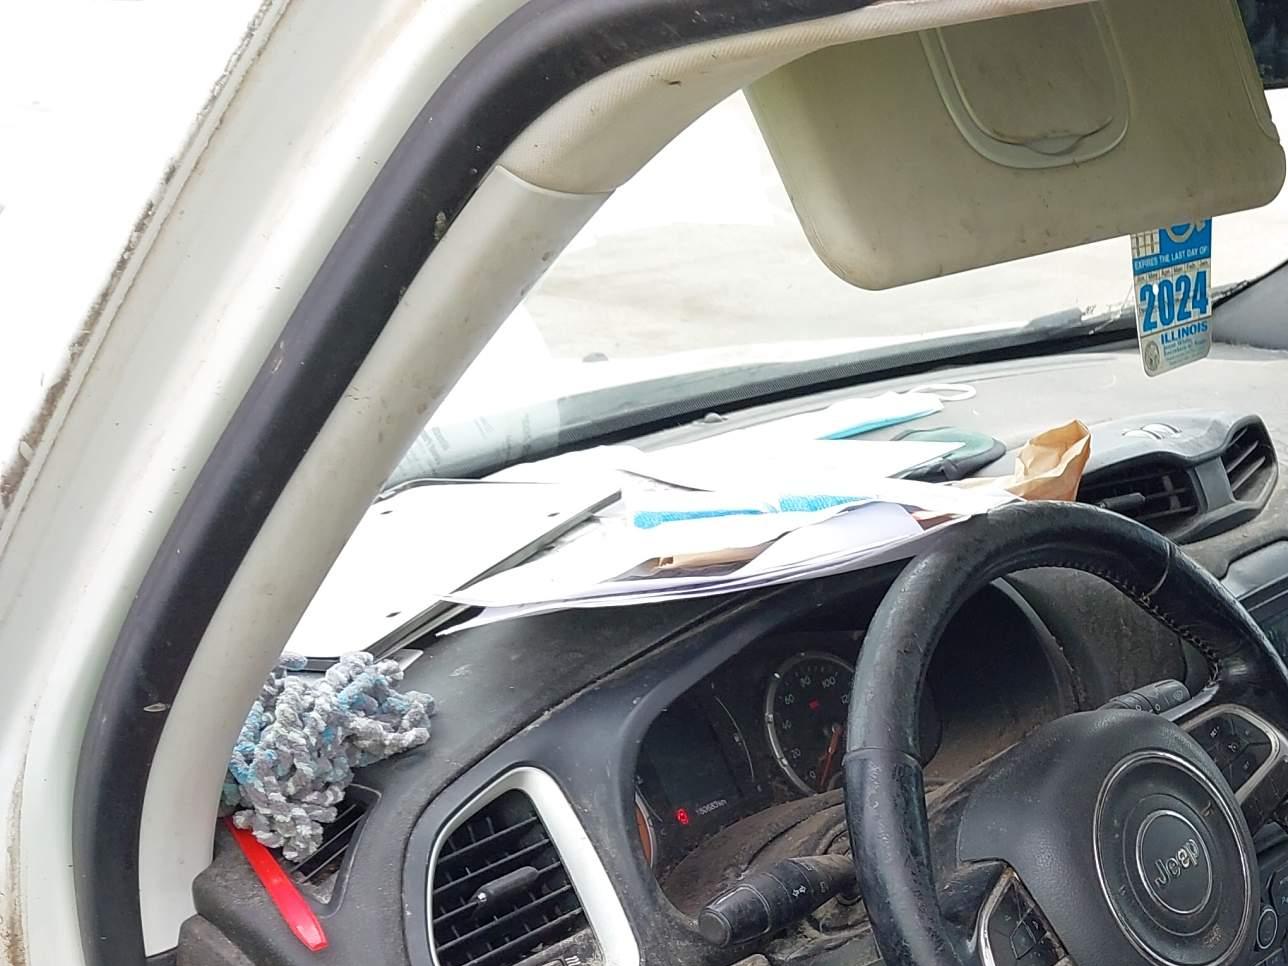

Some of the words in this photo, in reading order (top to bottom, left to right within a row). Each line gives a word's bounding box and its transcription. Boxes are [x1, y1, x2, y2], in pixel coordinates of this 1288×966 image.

[1133, 256, 1158, 270] EXPIRES
[1158, 254, 1170, 263] THE
[1170, 249, 1185, 260] LAST
[1185, 246, 1197, 257] DAY
[1198, 244, 1207, 254] OF
[1140, 271, 1208, 332] 2024
[1161, 321, 1208, 344] ILLINOIS
[821, 676, 836, 689] 100
[1154, 838, 1200, 888] Jeep
